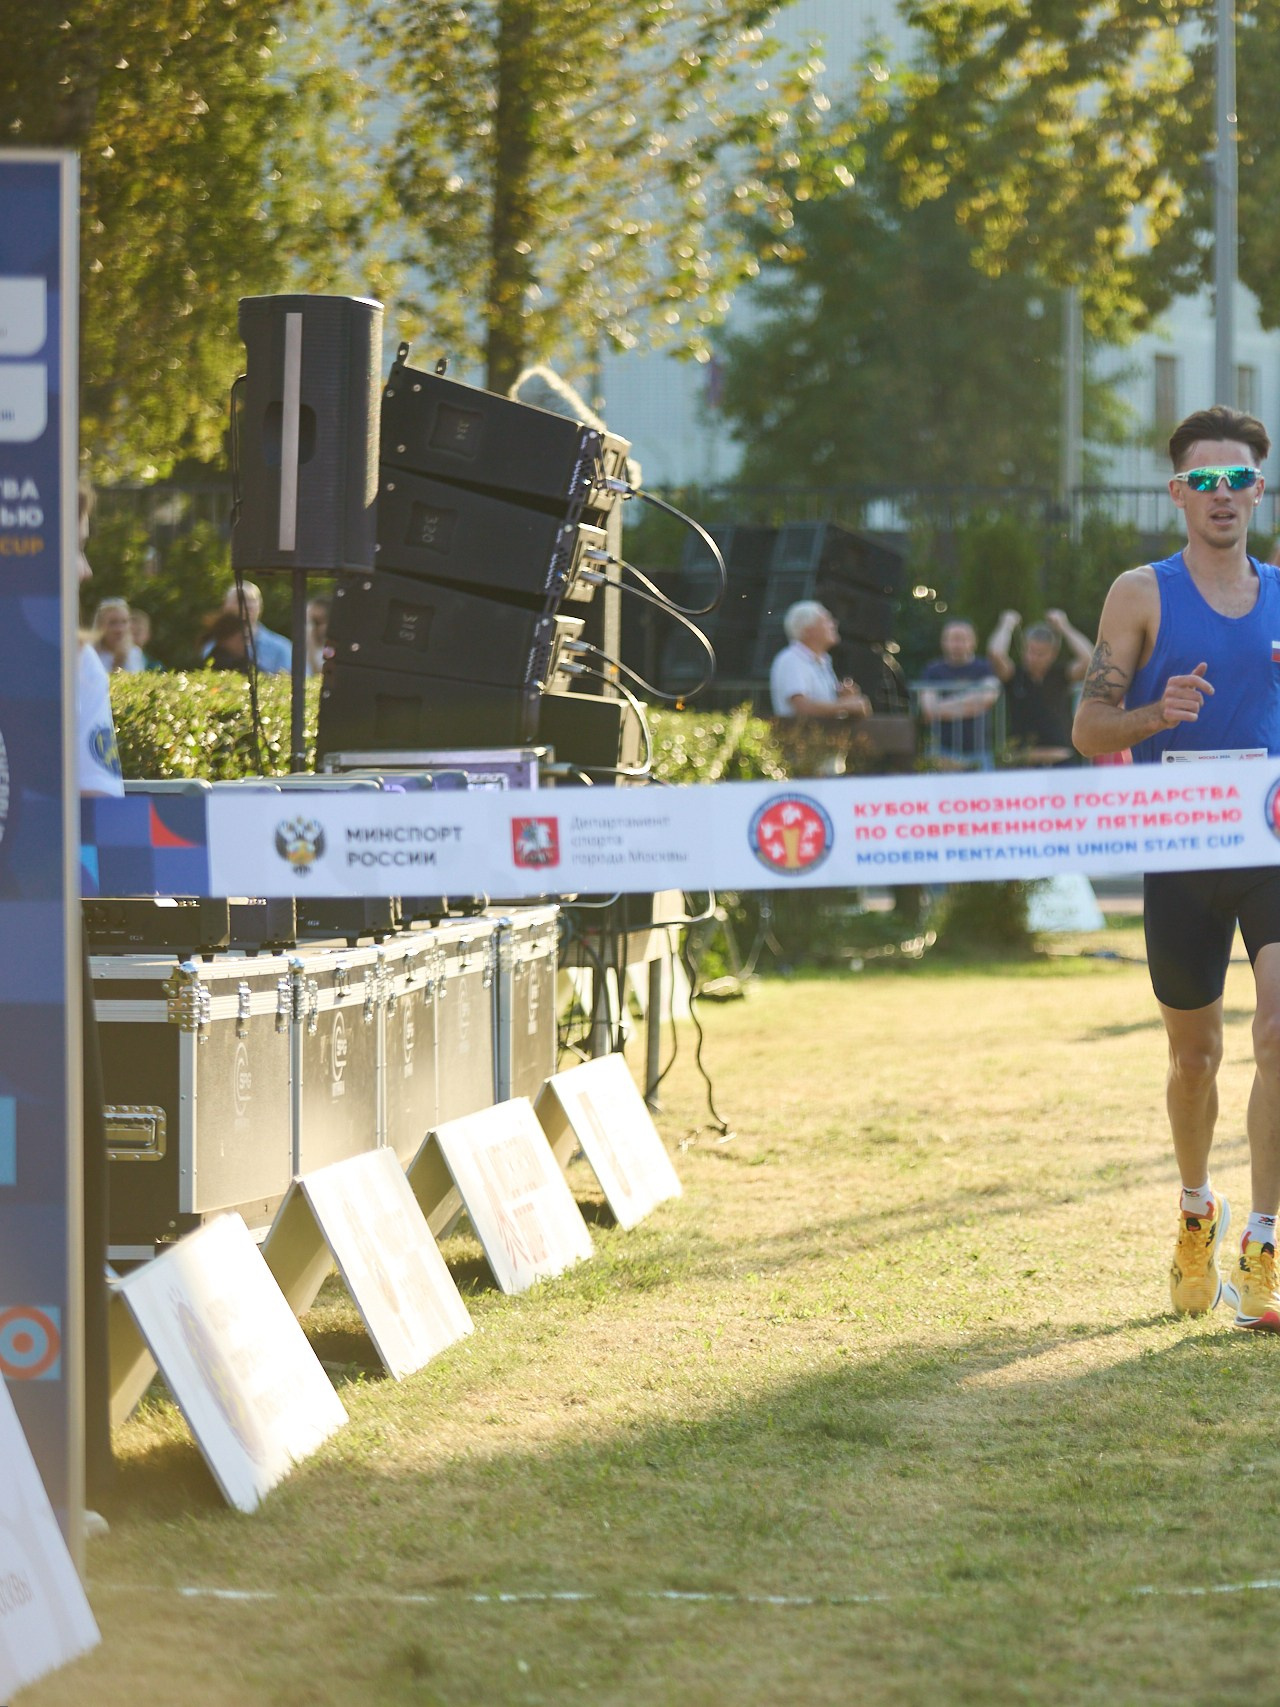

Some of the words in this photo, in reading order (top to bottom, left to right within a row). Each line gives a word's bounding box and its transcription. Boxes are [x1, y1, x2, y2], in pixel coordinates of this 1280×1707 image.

[0, 478, 40, 500] ВА
[854, 801, 930, 817] КУБОК
[938, 794, 1066, 814] СОЮЗНОГО
[1074, 785, 1241, 808] ГОСУДАРСТВА
[346, 827, 463, 842] МИНСПОРТ
[855, 825, 887, 841] ПО
[895, 817, 1088, 839] СОВРЕМЕННОМУ
[1097, 808, 1243, 831] ПЯТИБОРЬЮ
[347, 851, 437, 868] РОССИИ
[856, 850, 939, 865] MODERN
[945, 844, 1070, 862] PENTATHLON
[1077, 840, 1137, 857] UNION
[1144, 836, 1200, 853] STATE
[1207, 833, 1245, 849] CUP
